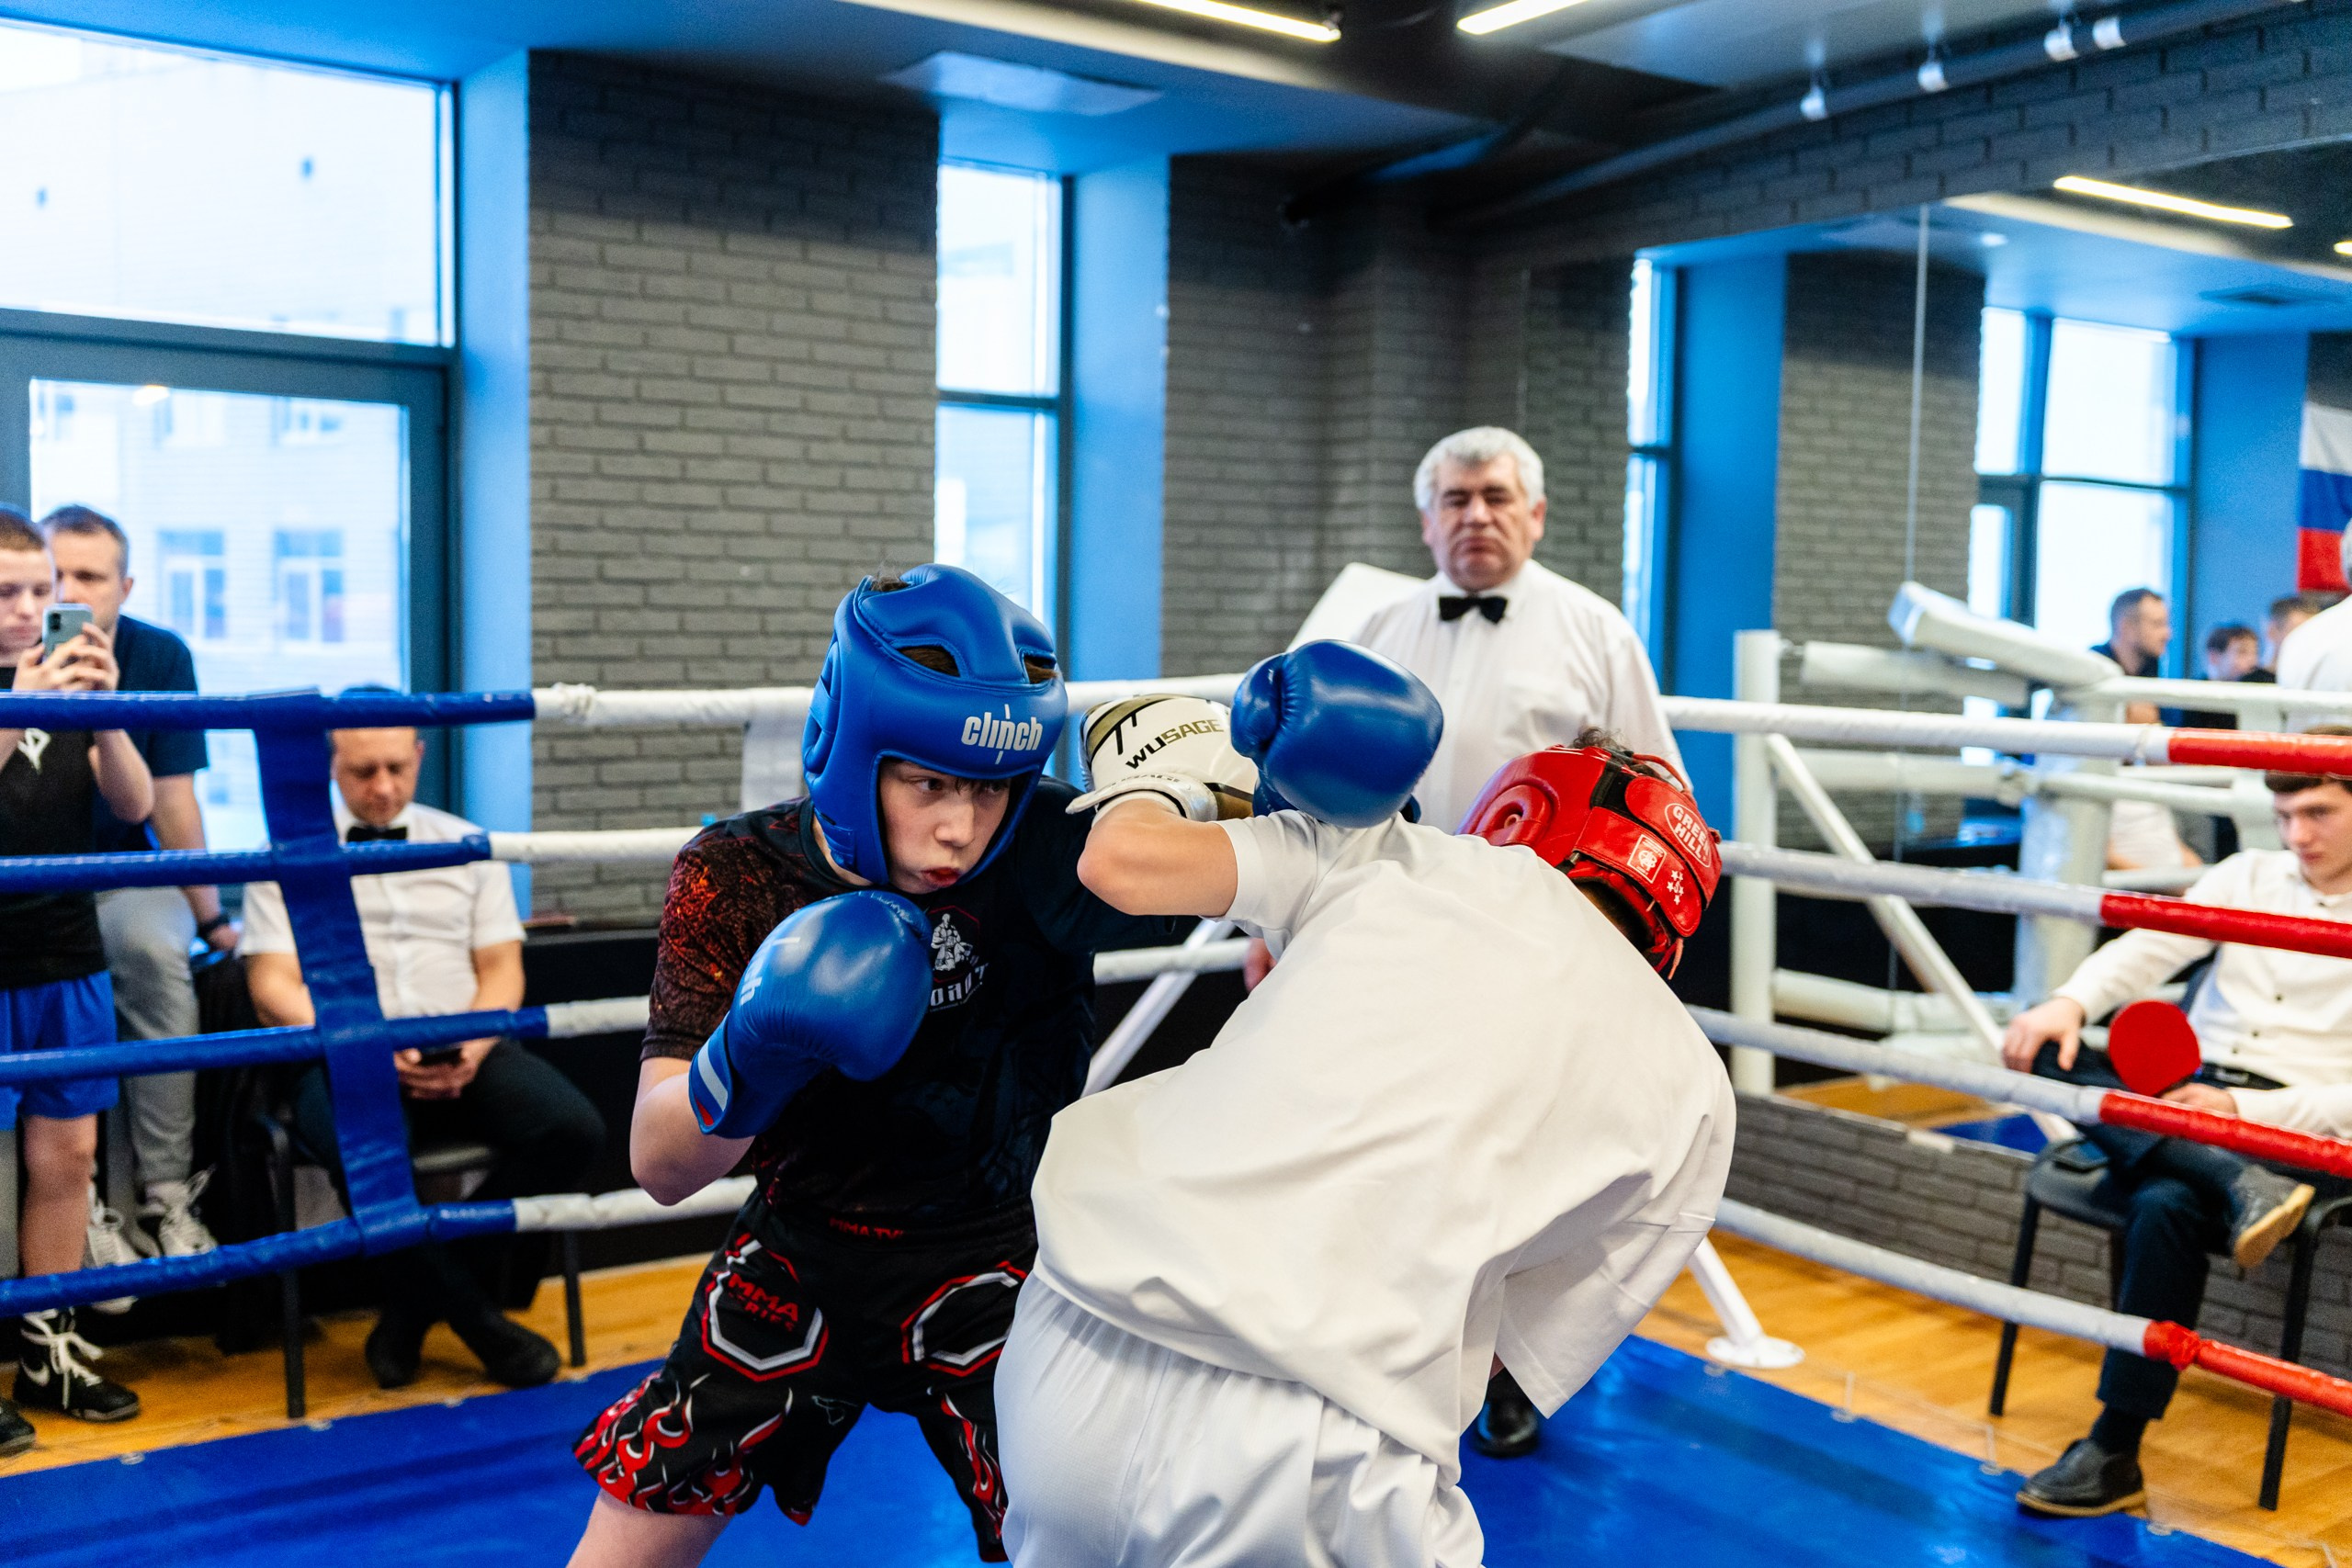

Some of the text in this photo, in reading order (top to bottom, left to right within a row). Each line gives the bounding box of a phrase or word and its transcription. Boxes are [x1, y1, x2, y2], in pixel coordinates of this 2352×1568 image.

[961, 705, 1043, 759] clinch
[1125, 719, 1225, 770] WUSAGE
[1674, 822, 1702, 860] HILL
[729, 1273, 798, 1322] MMA
